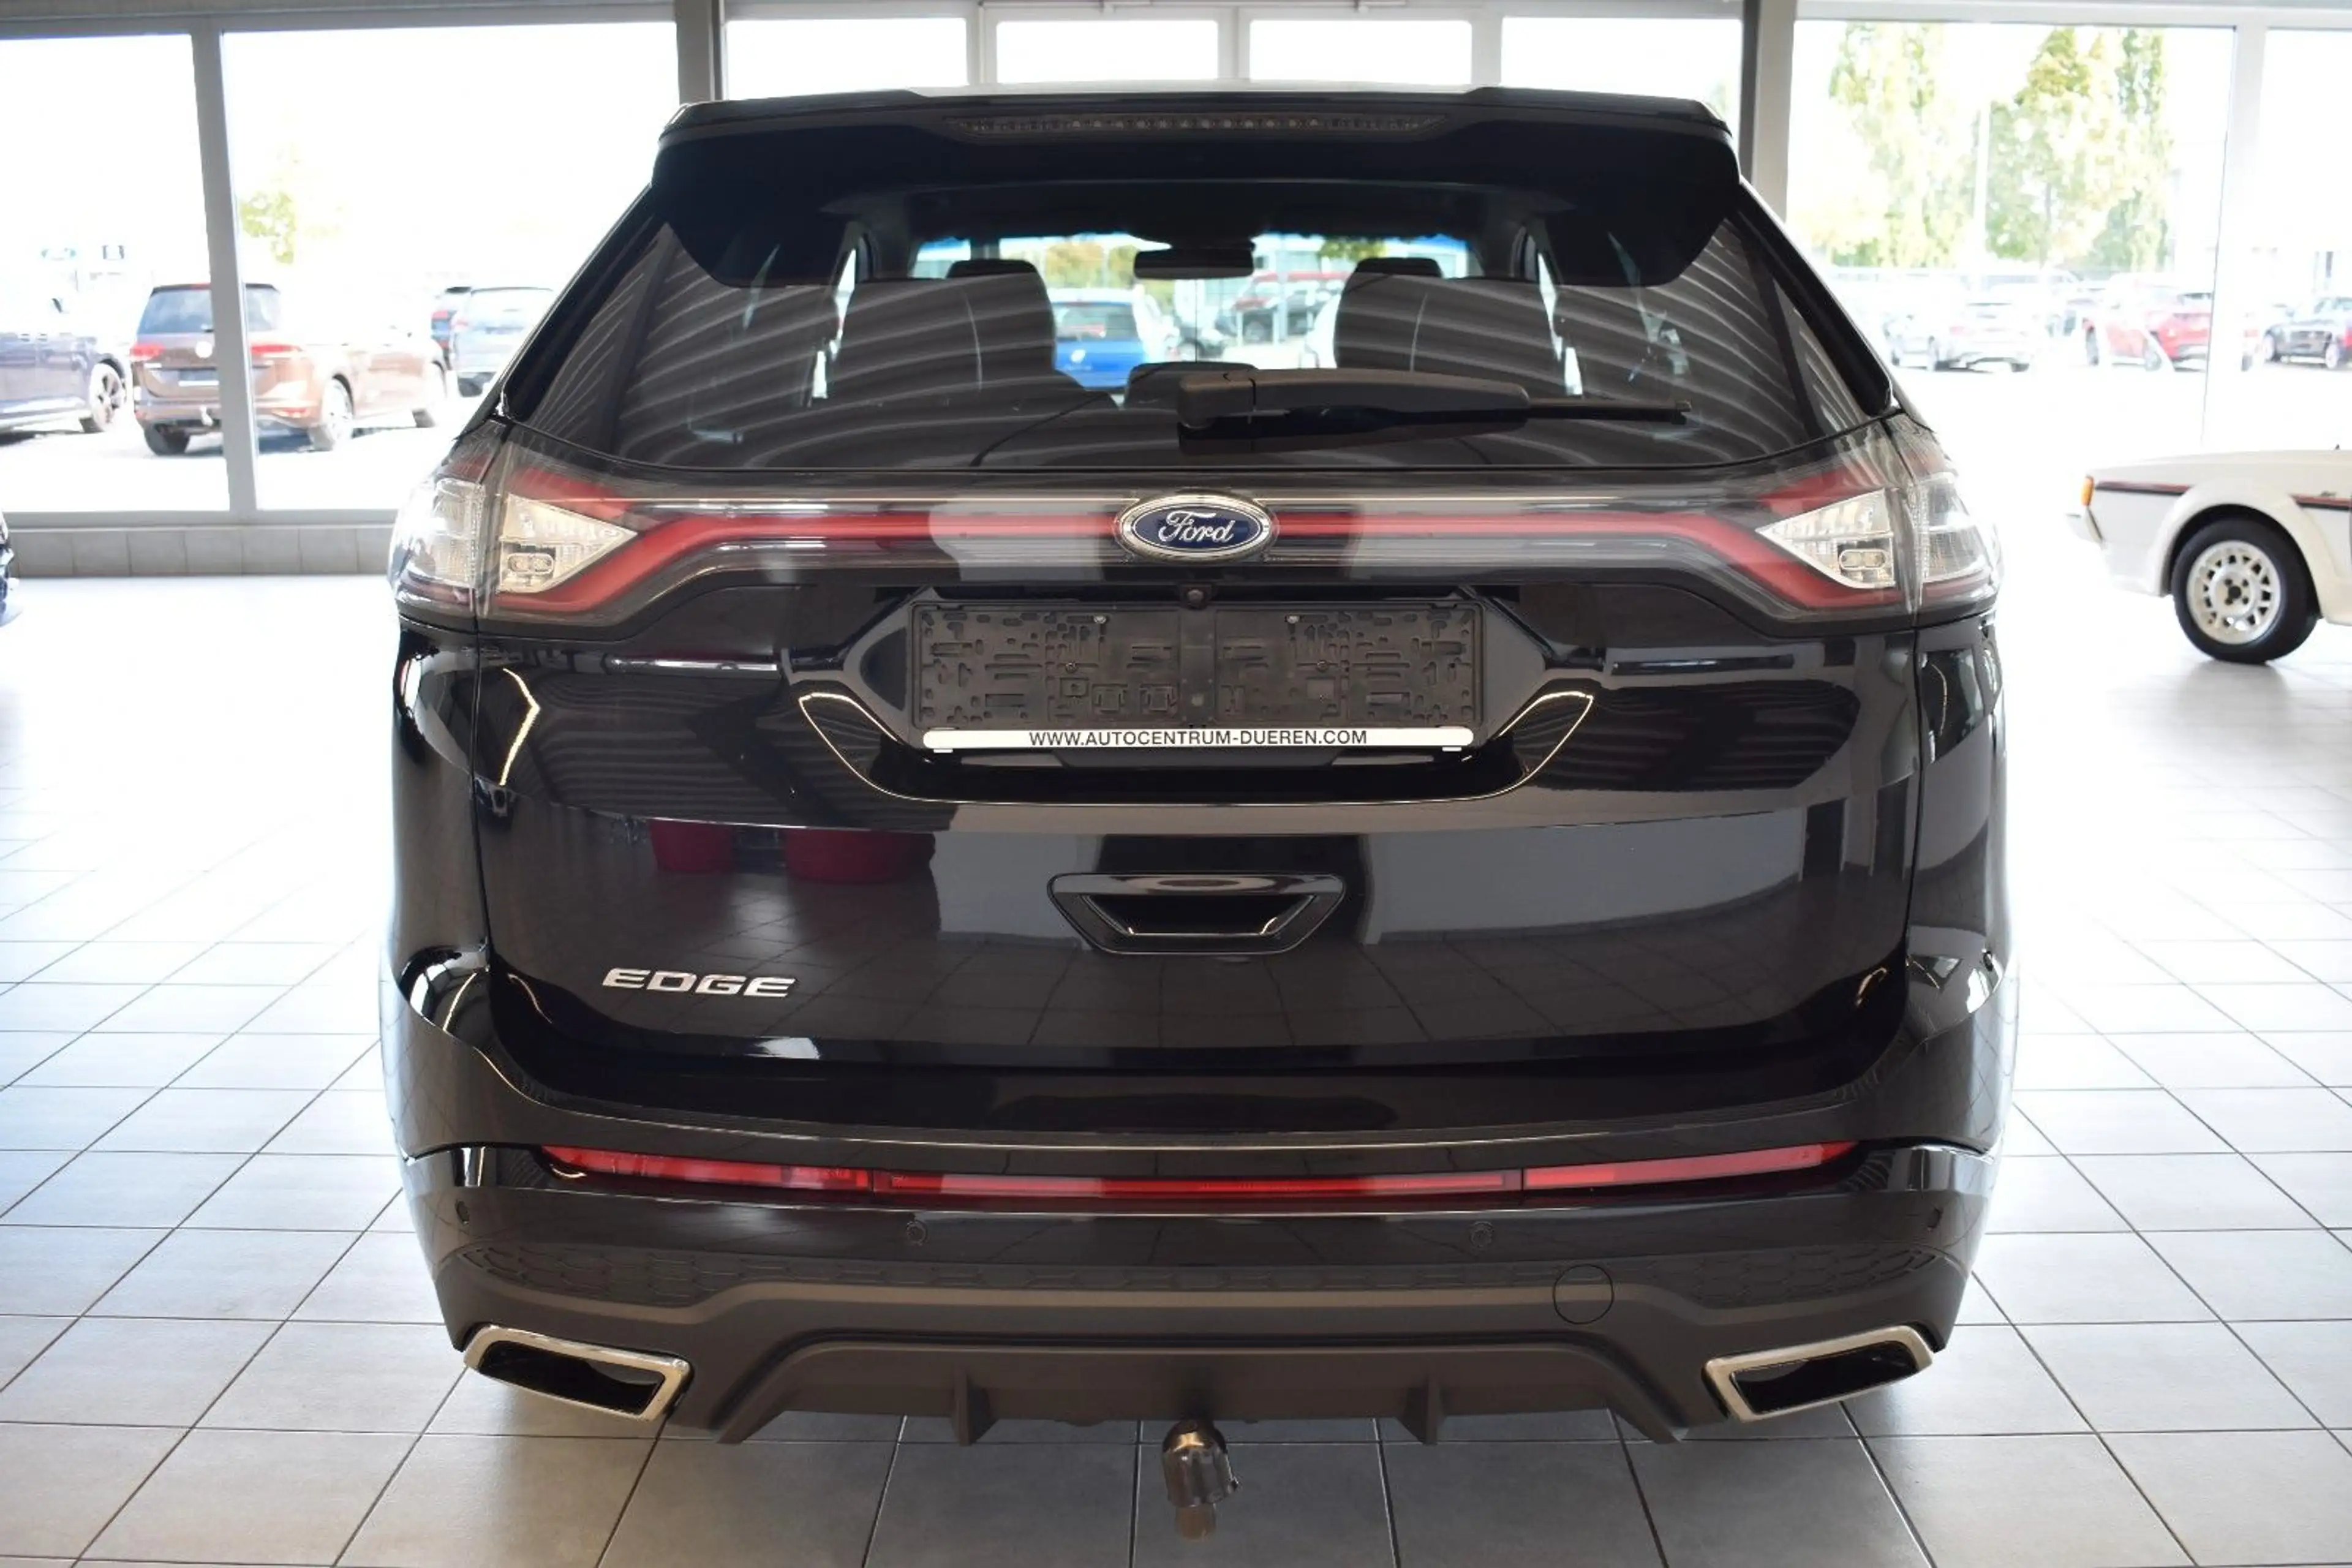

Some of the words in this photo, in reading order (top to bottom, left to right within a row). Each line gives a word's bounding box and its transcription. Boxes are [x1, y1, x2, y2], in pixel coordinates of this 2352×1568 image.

[1158, 510, 1235, 542] Ford
[1028, 729, 1367, 746] WWW.AUTOCENTRUM-DUEREN.COM
[602, 967, 796, 997] EDGE
